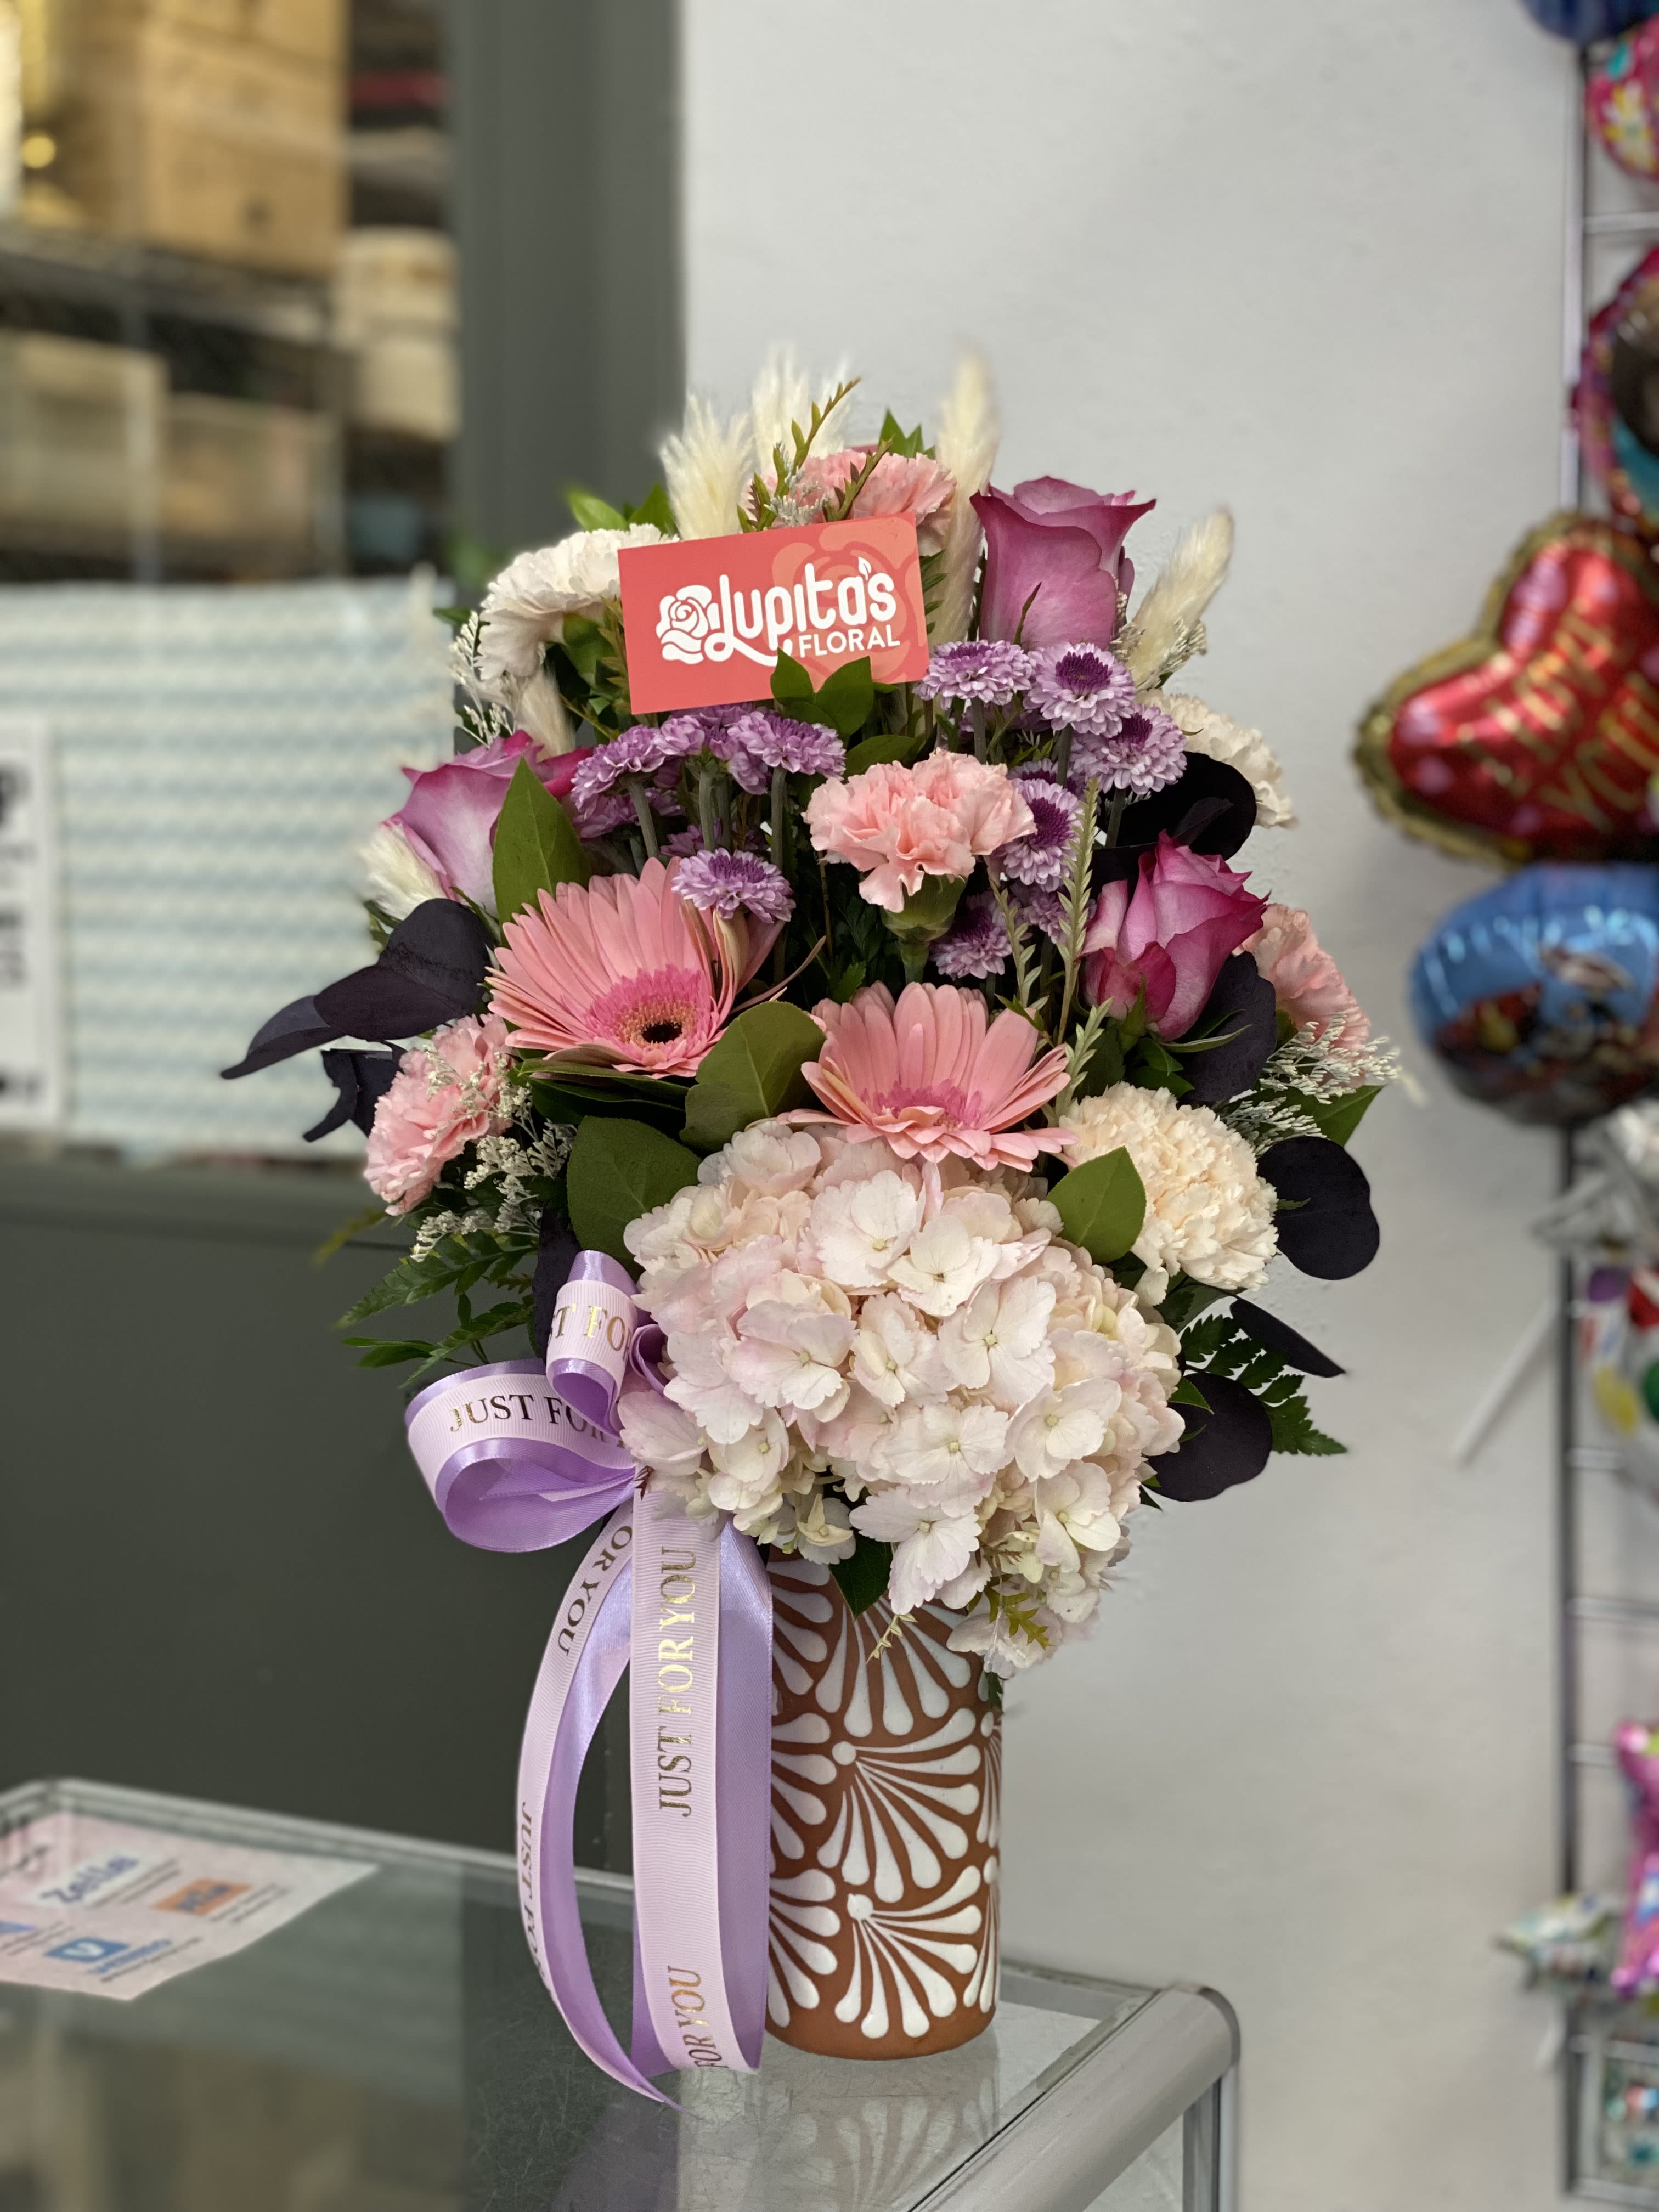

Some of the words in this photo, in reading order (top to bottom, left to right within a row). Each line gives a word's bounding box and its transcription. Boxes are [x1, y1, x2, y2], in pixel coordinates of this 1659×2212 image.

[704, 556, 897, 667] Lupita's
[799, 624, 900, 658] FLORAL
[450, 1394, 534, 1432] JUST
[558, 1578, 600, 1657] YOU
[660, 1546, 696, 1630] YOU
[658, 1635, 695, 1716] FOR
[657, 1726, 692, 1818] JUST
[522, 1802, 533, 1900] JUST
[668, 1965, 709, 2028] YOU
